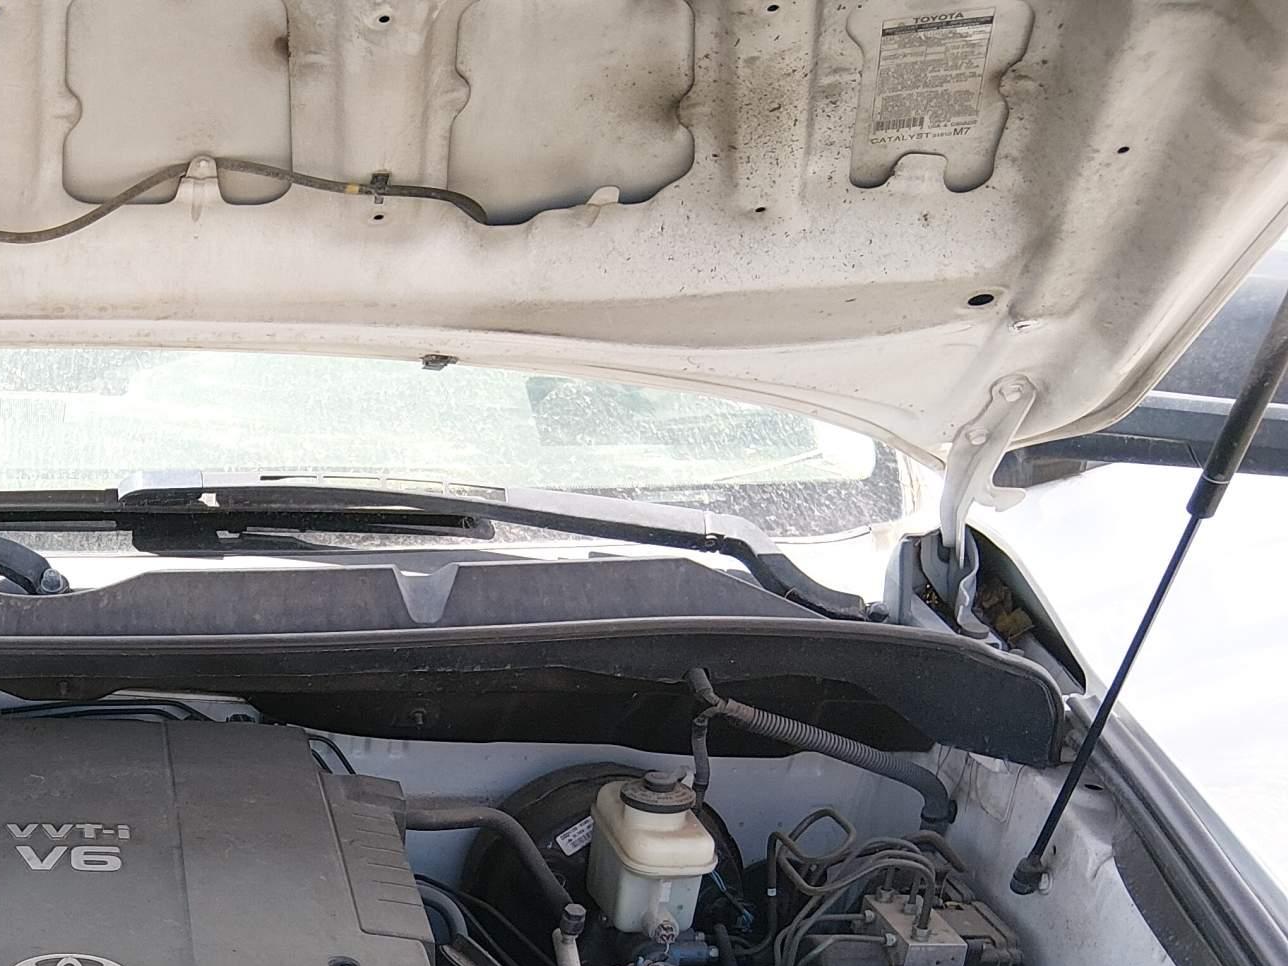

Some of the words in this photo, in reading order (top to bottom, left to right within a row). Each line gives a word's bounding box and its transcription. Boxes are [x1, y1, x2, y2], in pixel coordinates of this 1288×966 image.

[913, 11, 964, 24] TOYOTA
[870, 132, 930, 144] CATALYST
[953, 127, 971, 136] M7
[7, 823, 130, 840] VVT-i
[16, 845, 122, 871] V6
